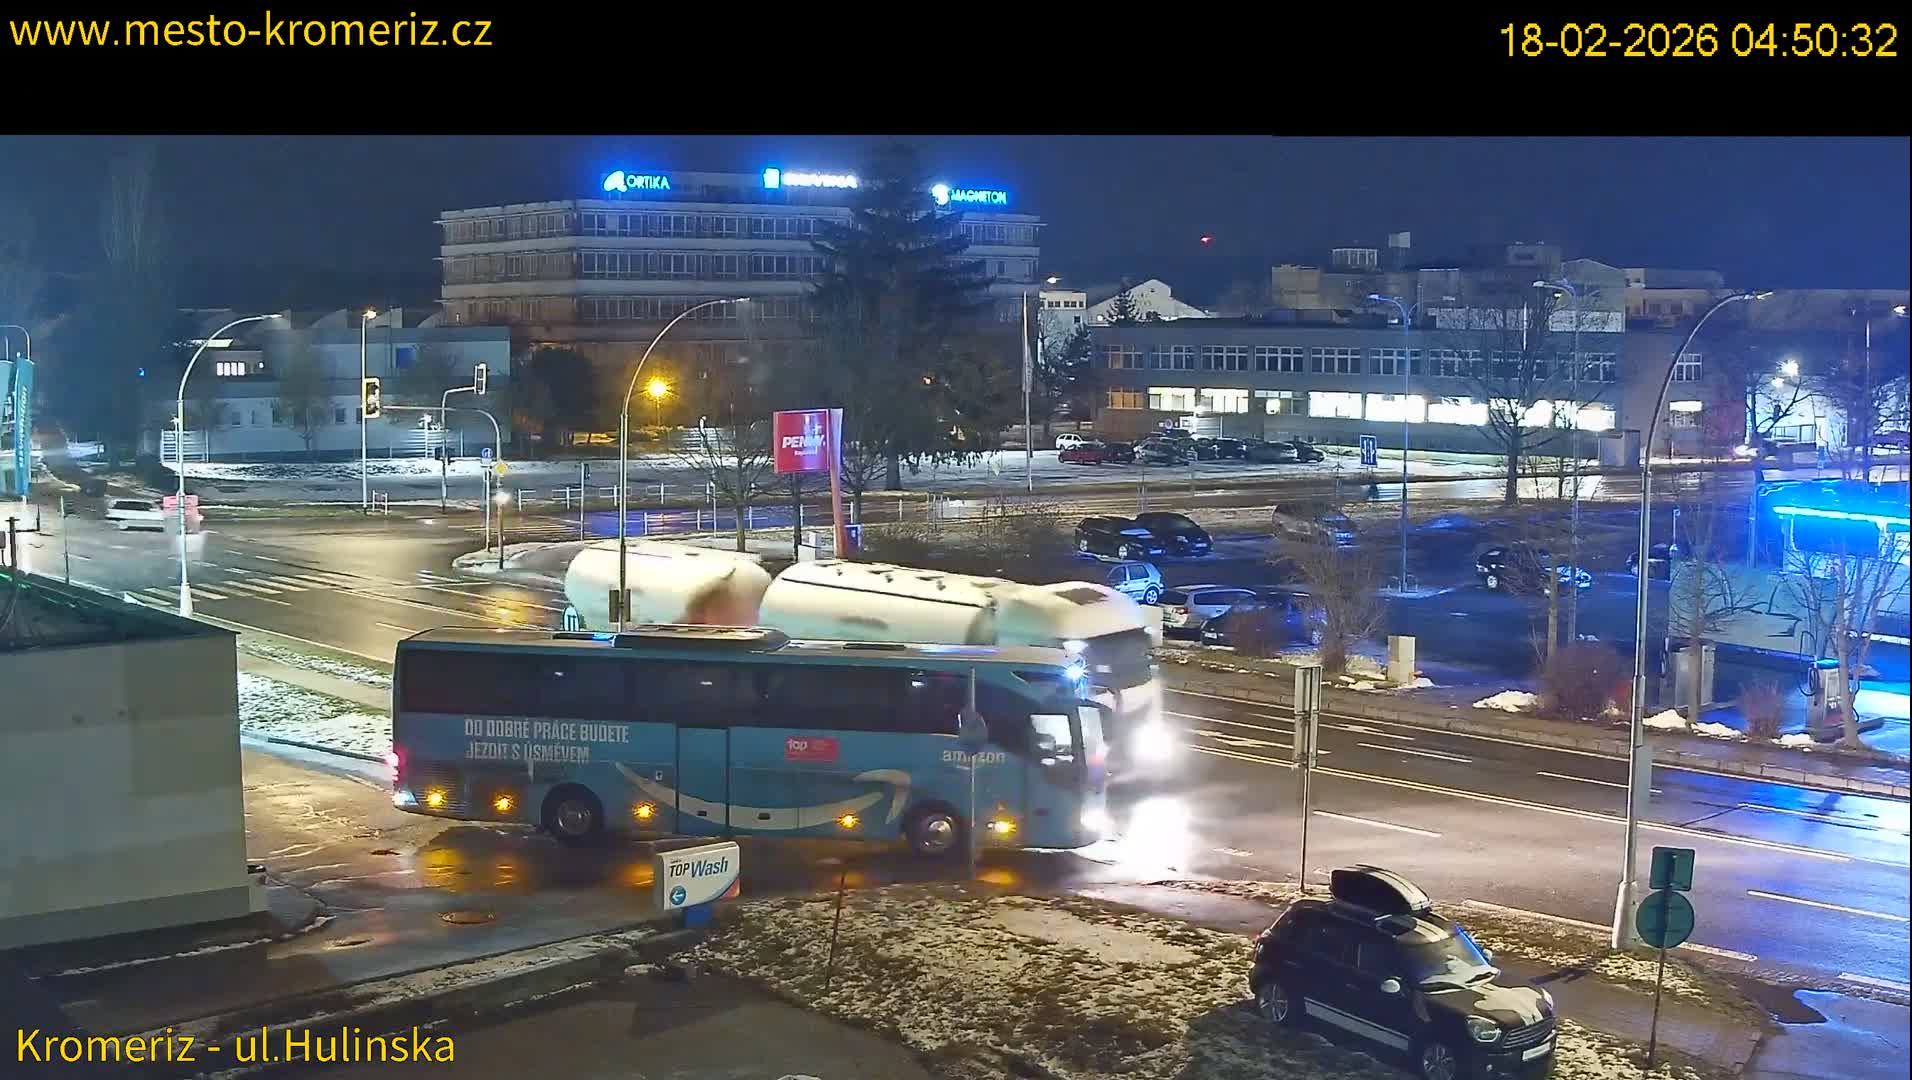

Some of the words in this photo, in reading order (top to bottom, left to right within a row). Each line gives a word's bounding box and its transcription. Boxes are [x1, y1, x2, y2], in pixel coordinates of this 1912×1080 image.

[626, 174, 671, 190] ORTIKA
[486, 717, 529, 739] DOBRÉ
[533, 719, 576, 741] PRÁCE
[580, 723, 629, 743] BUDETE
[512, 742, 521, 761] S
